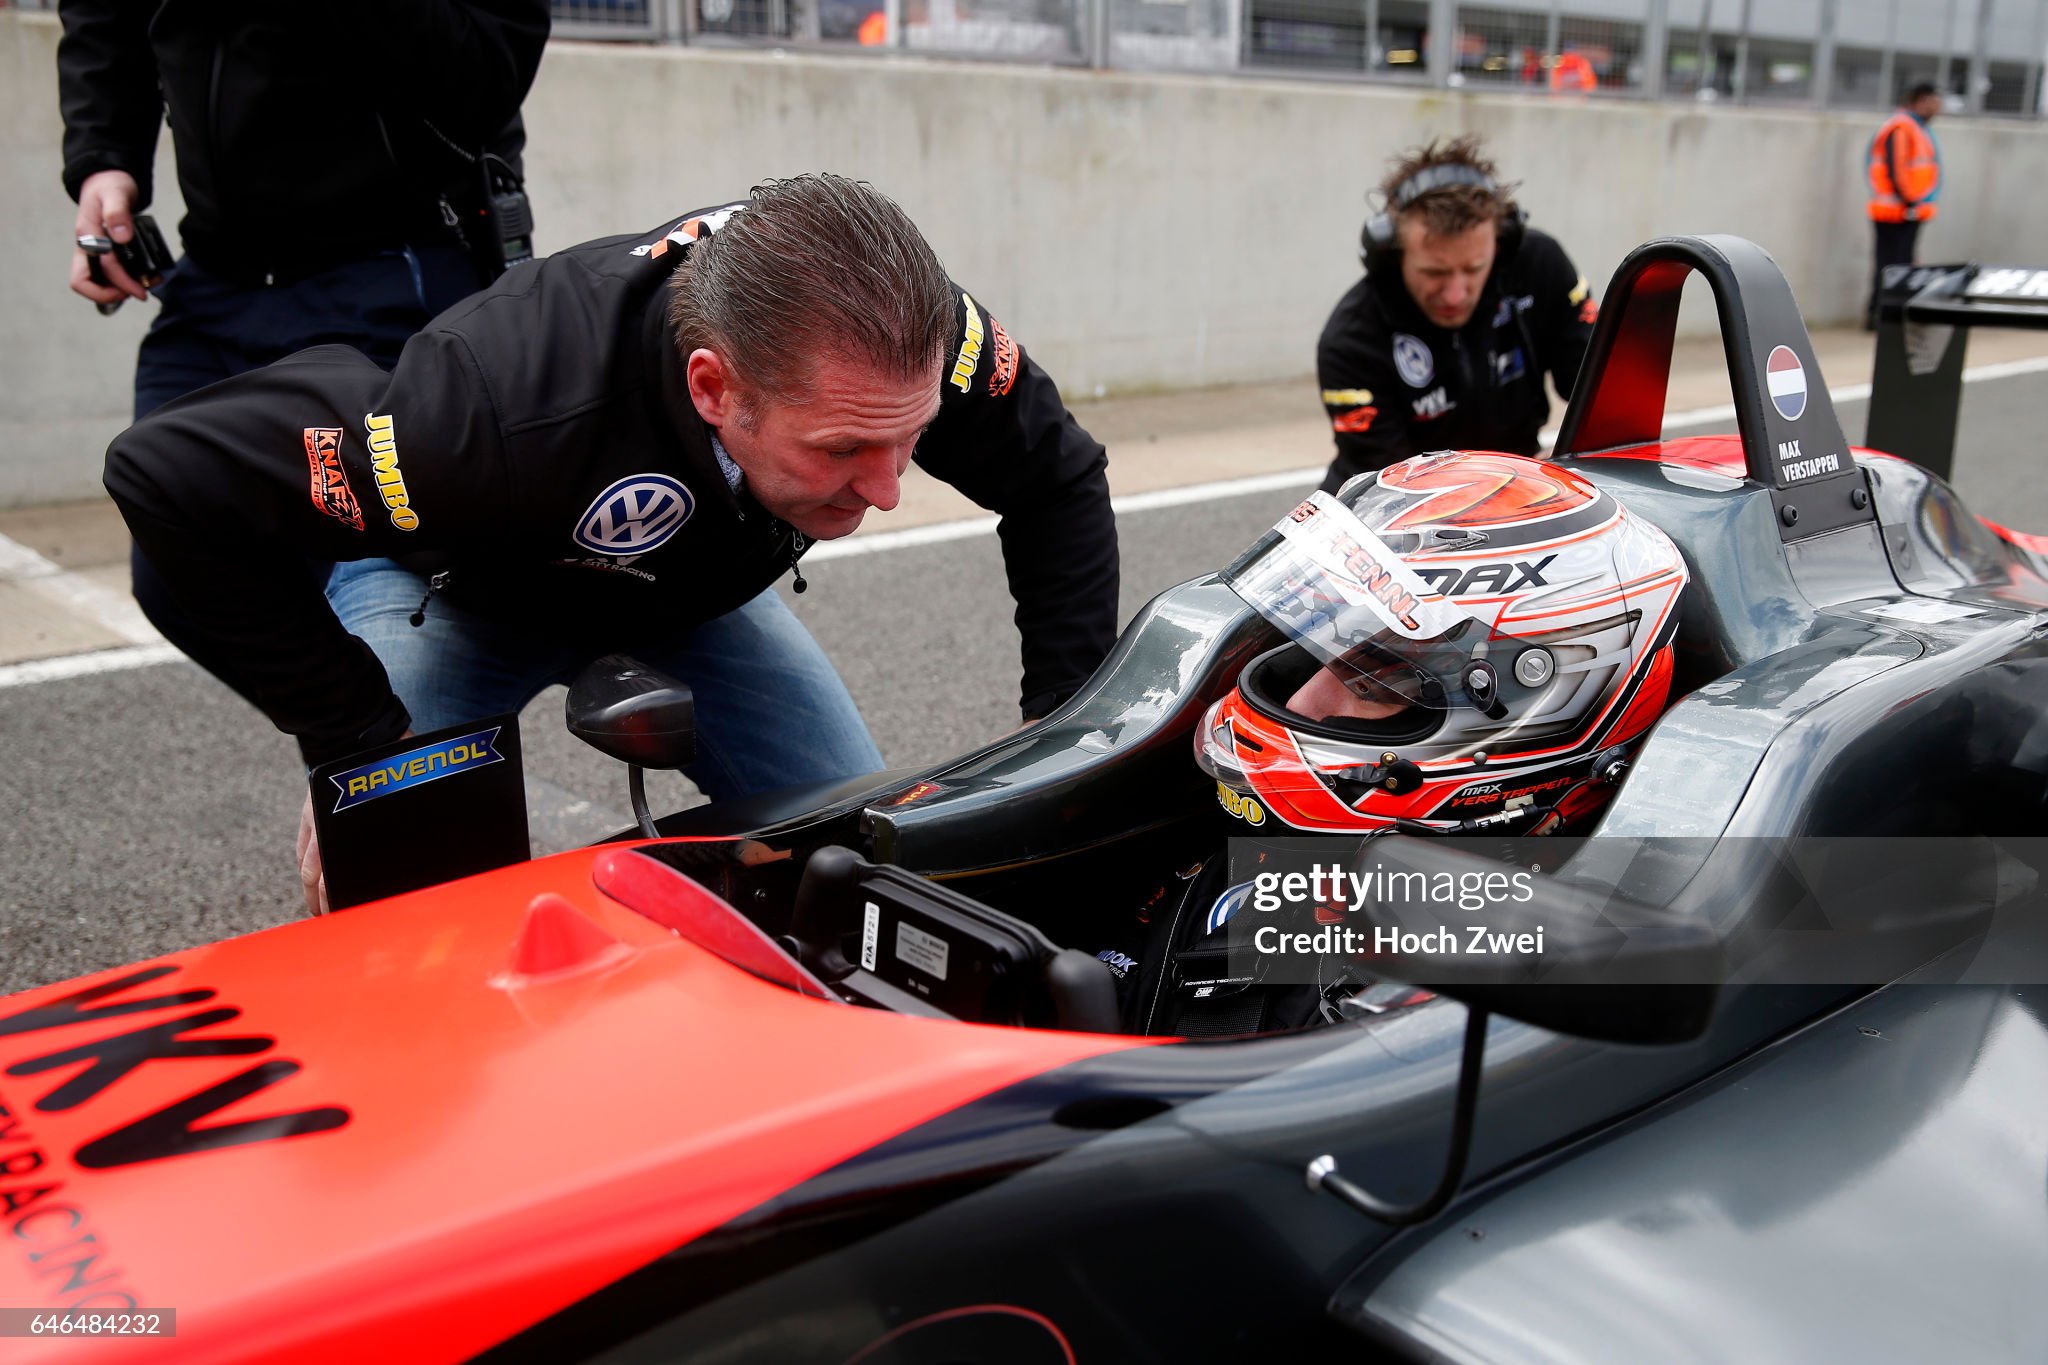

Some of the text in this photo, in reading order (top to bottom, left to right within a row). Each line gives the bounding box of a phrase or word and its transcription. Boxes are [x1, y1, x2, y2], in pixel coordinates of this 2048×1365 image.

[1778, 440, 1801, 460] MAX
[318, 431, 347, 501] KNAF
[364, 413, 419, 531] JUMBO
[1782, 454, 1839, 482] VERSTAPPEN
[611, 564, 656, 581] RACING
[1412, 554, 1559, 596] MAX
[348, 743, 487, 797] RAVENOL
[1451, 777, 1571, 807] VERSTAPPEN
[1461, 784, 1502, 797] MAX
[1195, 987, 1213, 996] OMP
